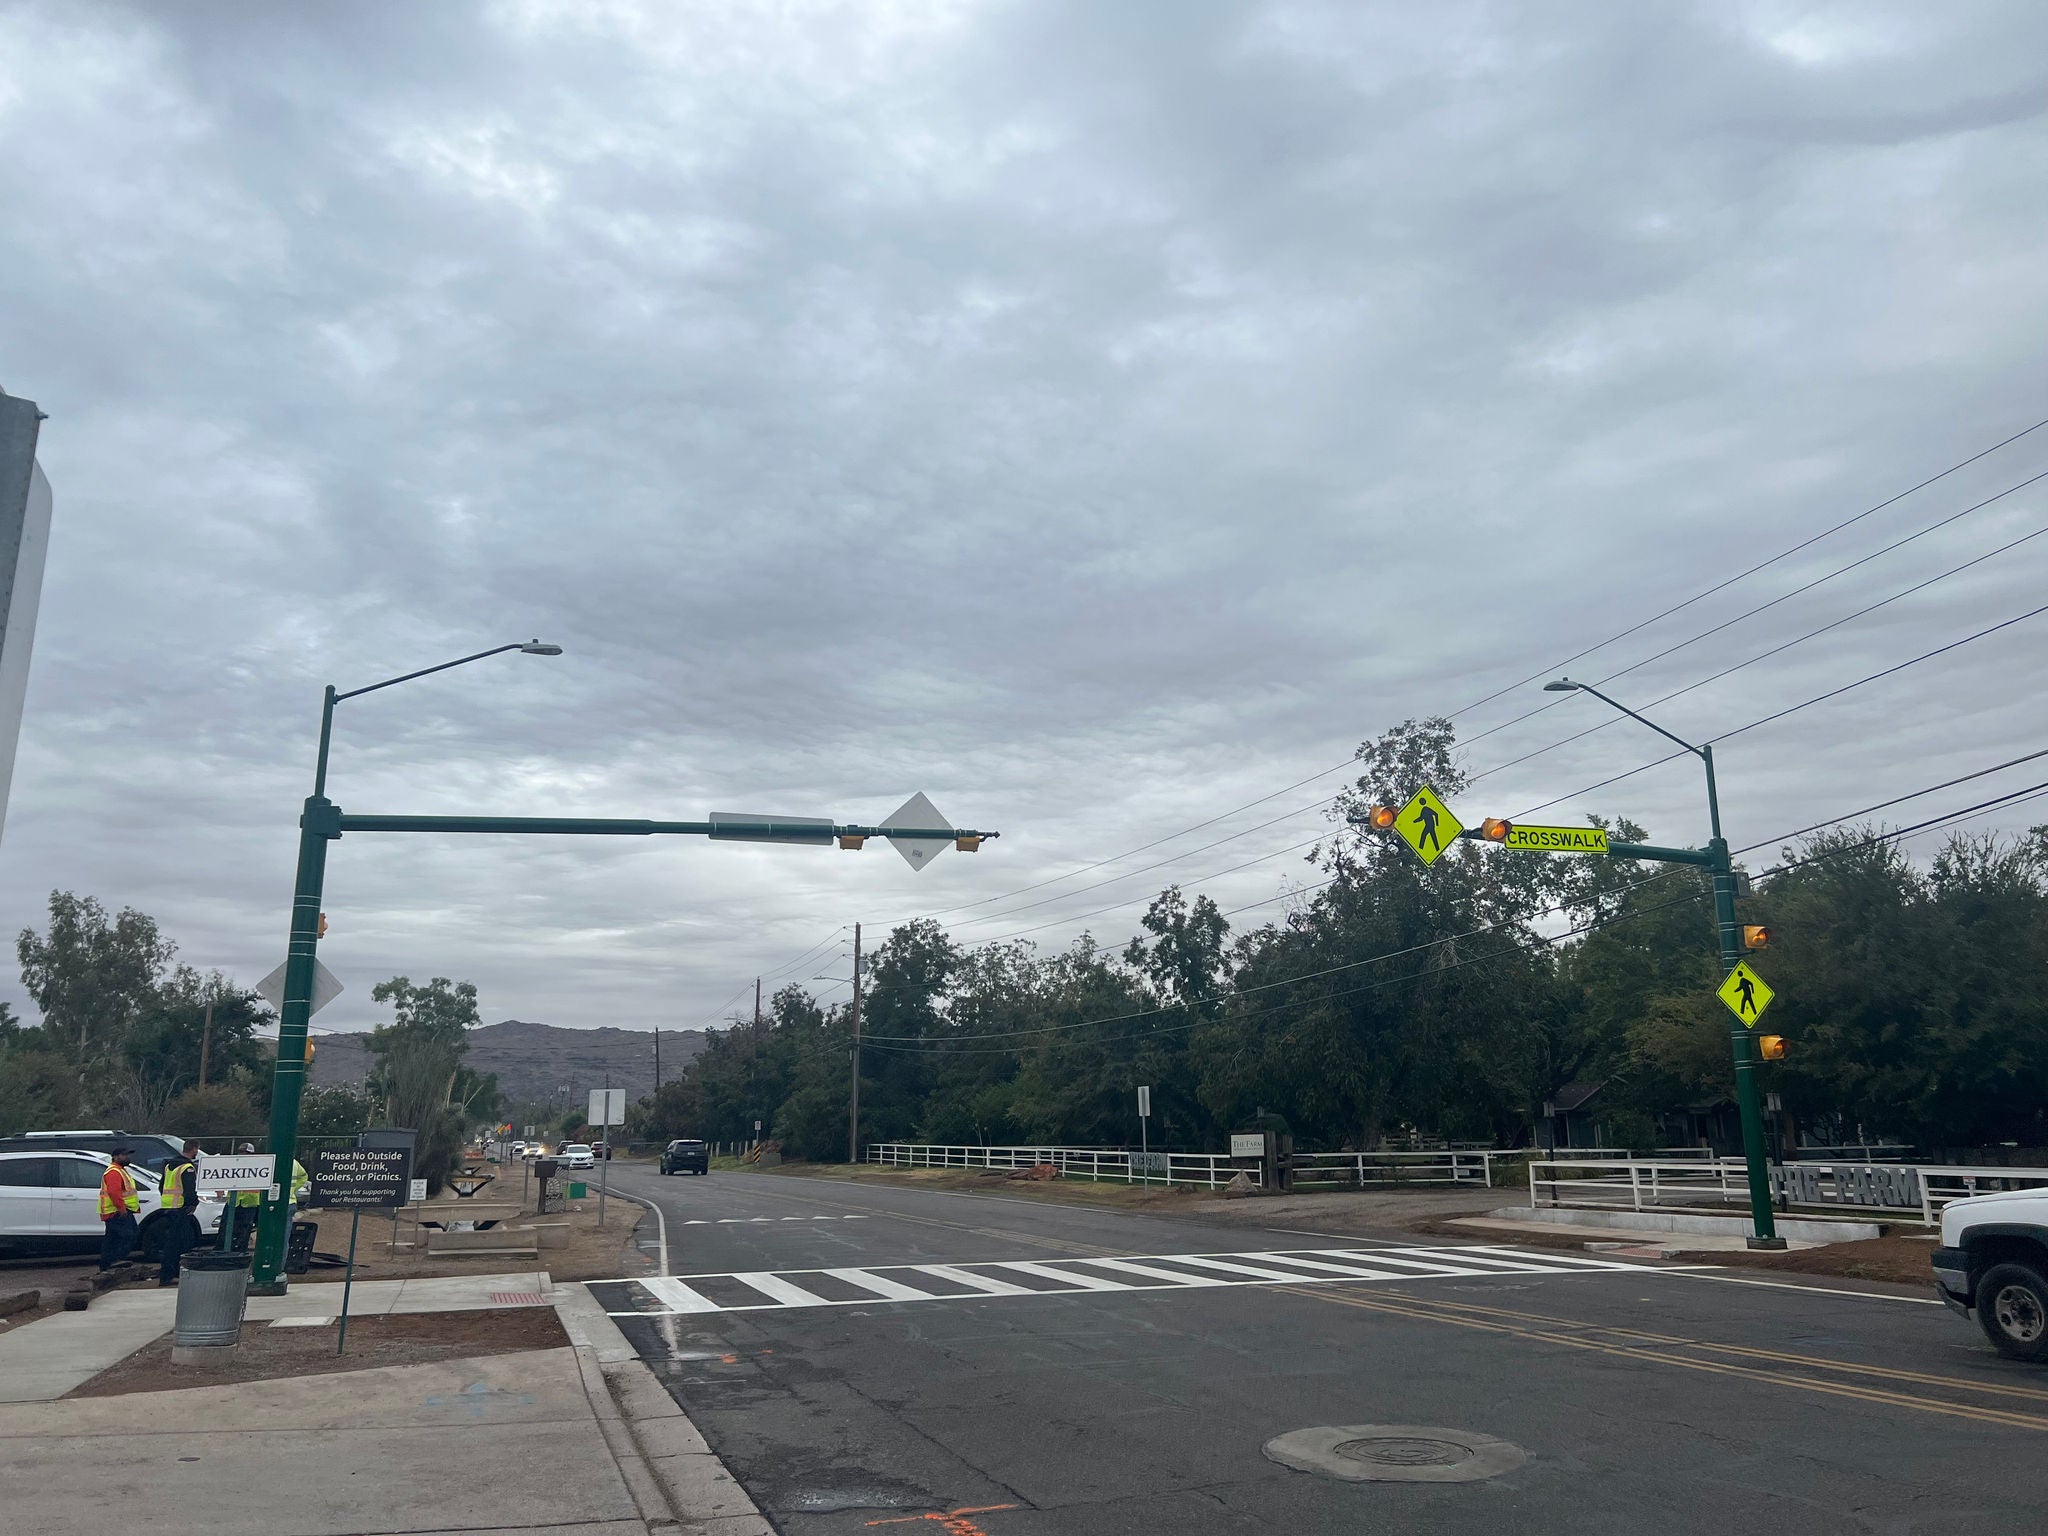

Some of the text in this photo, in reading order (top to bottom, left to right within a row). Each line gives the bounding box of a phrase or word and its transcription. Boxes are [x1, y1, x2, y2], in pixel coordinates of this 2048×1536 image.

[1507, 831, 1605, 848] CROSSWALK
[320, 1151, 402, 1160] Please No Outside
[332, 1162, 388, 1171] Food, Drink,
[202, 1167, 269, 1179] PARKING
[316, 1172, 354, 1182] Coolers,
[367, 1172, 402, 1181] Picnics.
[1831, 1166, 1922, 1206] FARM
[320, 1188, 339, 1196] Thank
[352, 1188, 362, 1197] for
[362, 1188, 396, 1197] supporting
